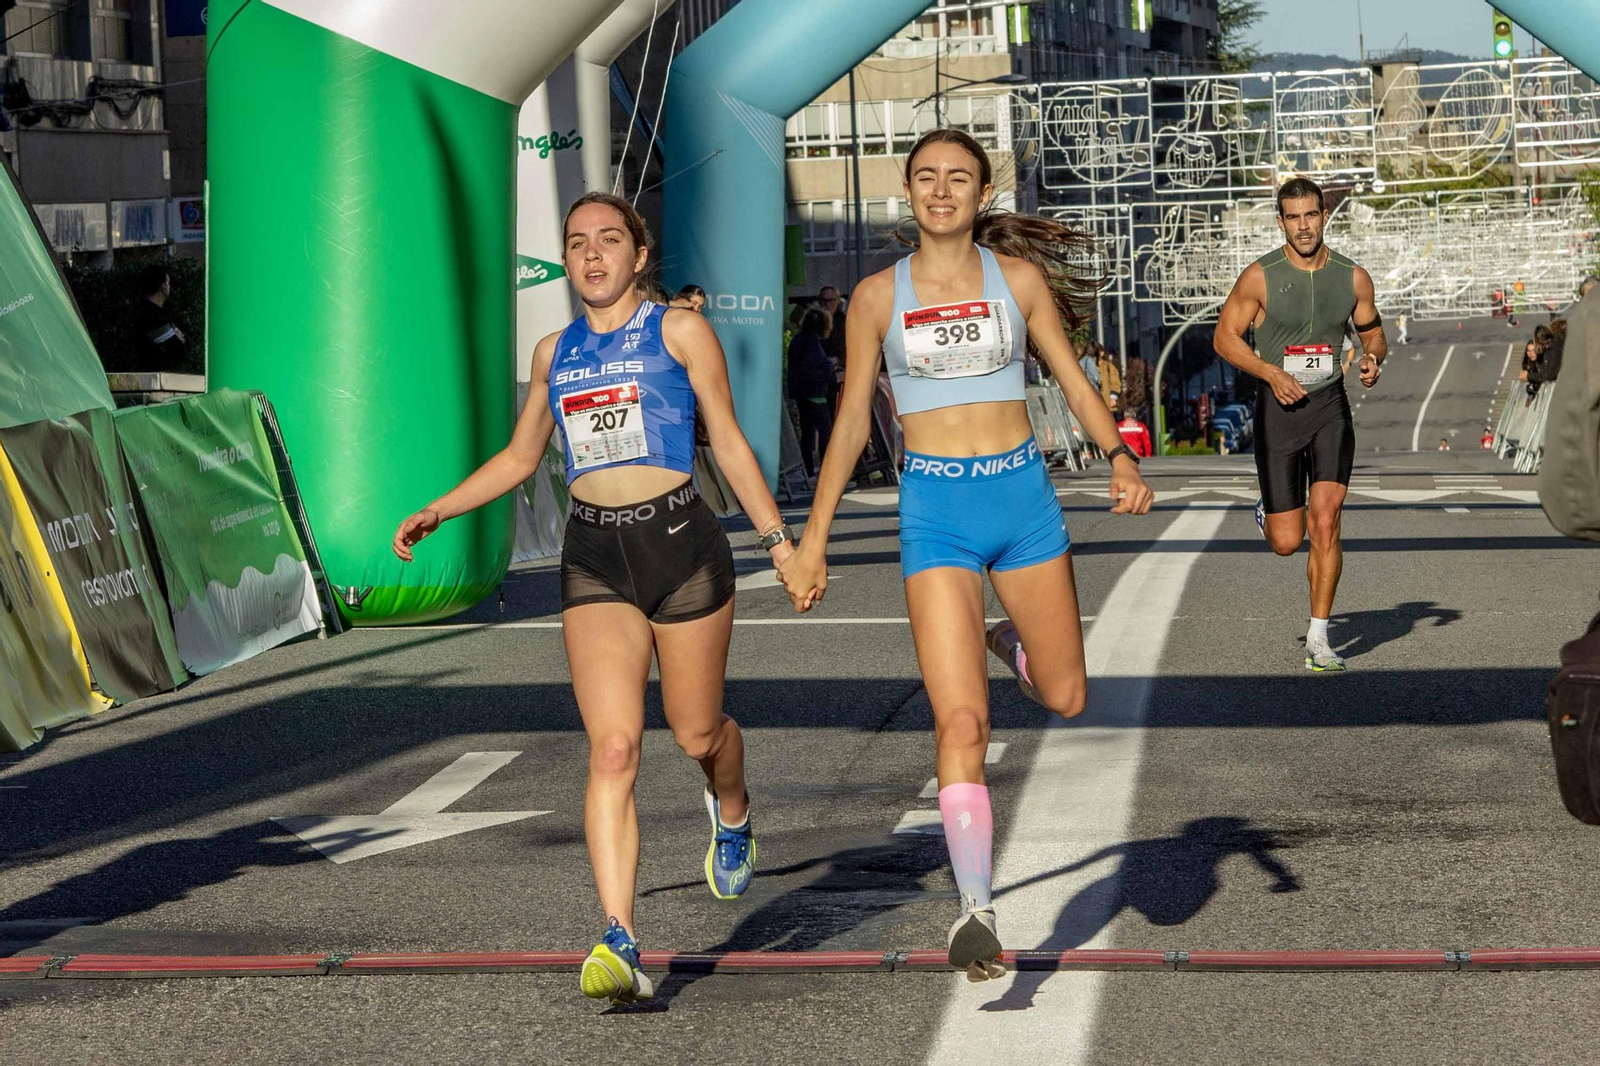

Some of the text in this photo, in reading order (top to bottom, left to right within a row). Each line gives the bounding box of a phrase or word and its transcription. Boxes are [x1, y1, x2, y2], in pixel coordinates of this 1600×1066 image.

[933, 322, 981, 346] 398
[555, 361, 644, 386] SOLISS
[1305, 357, 1320, 368] 21
[590, 408, 629, 433] 207
[910, 458, 964, 478] PRO
[971, 449, 1026, 477] NIKE
[600, 504, 656, 527] PRO
